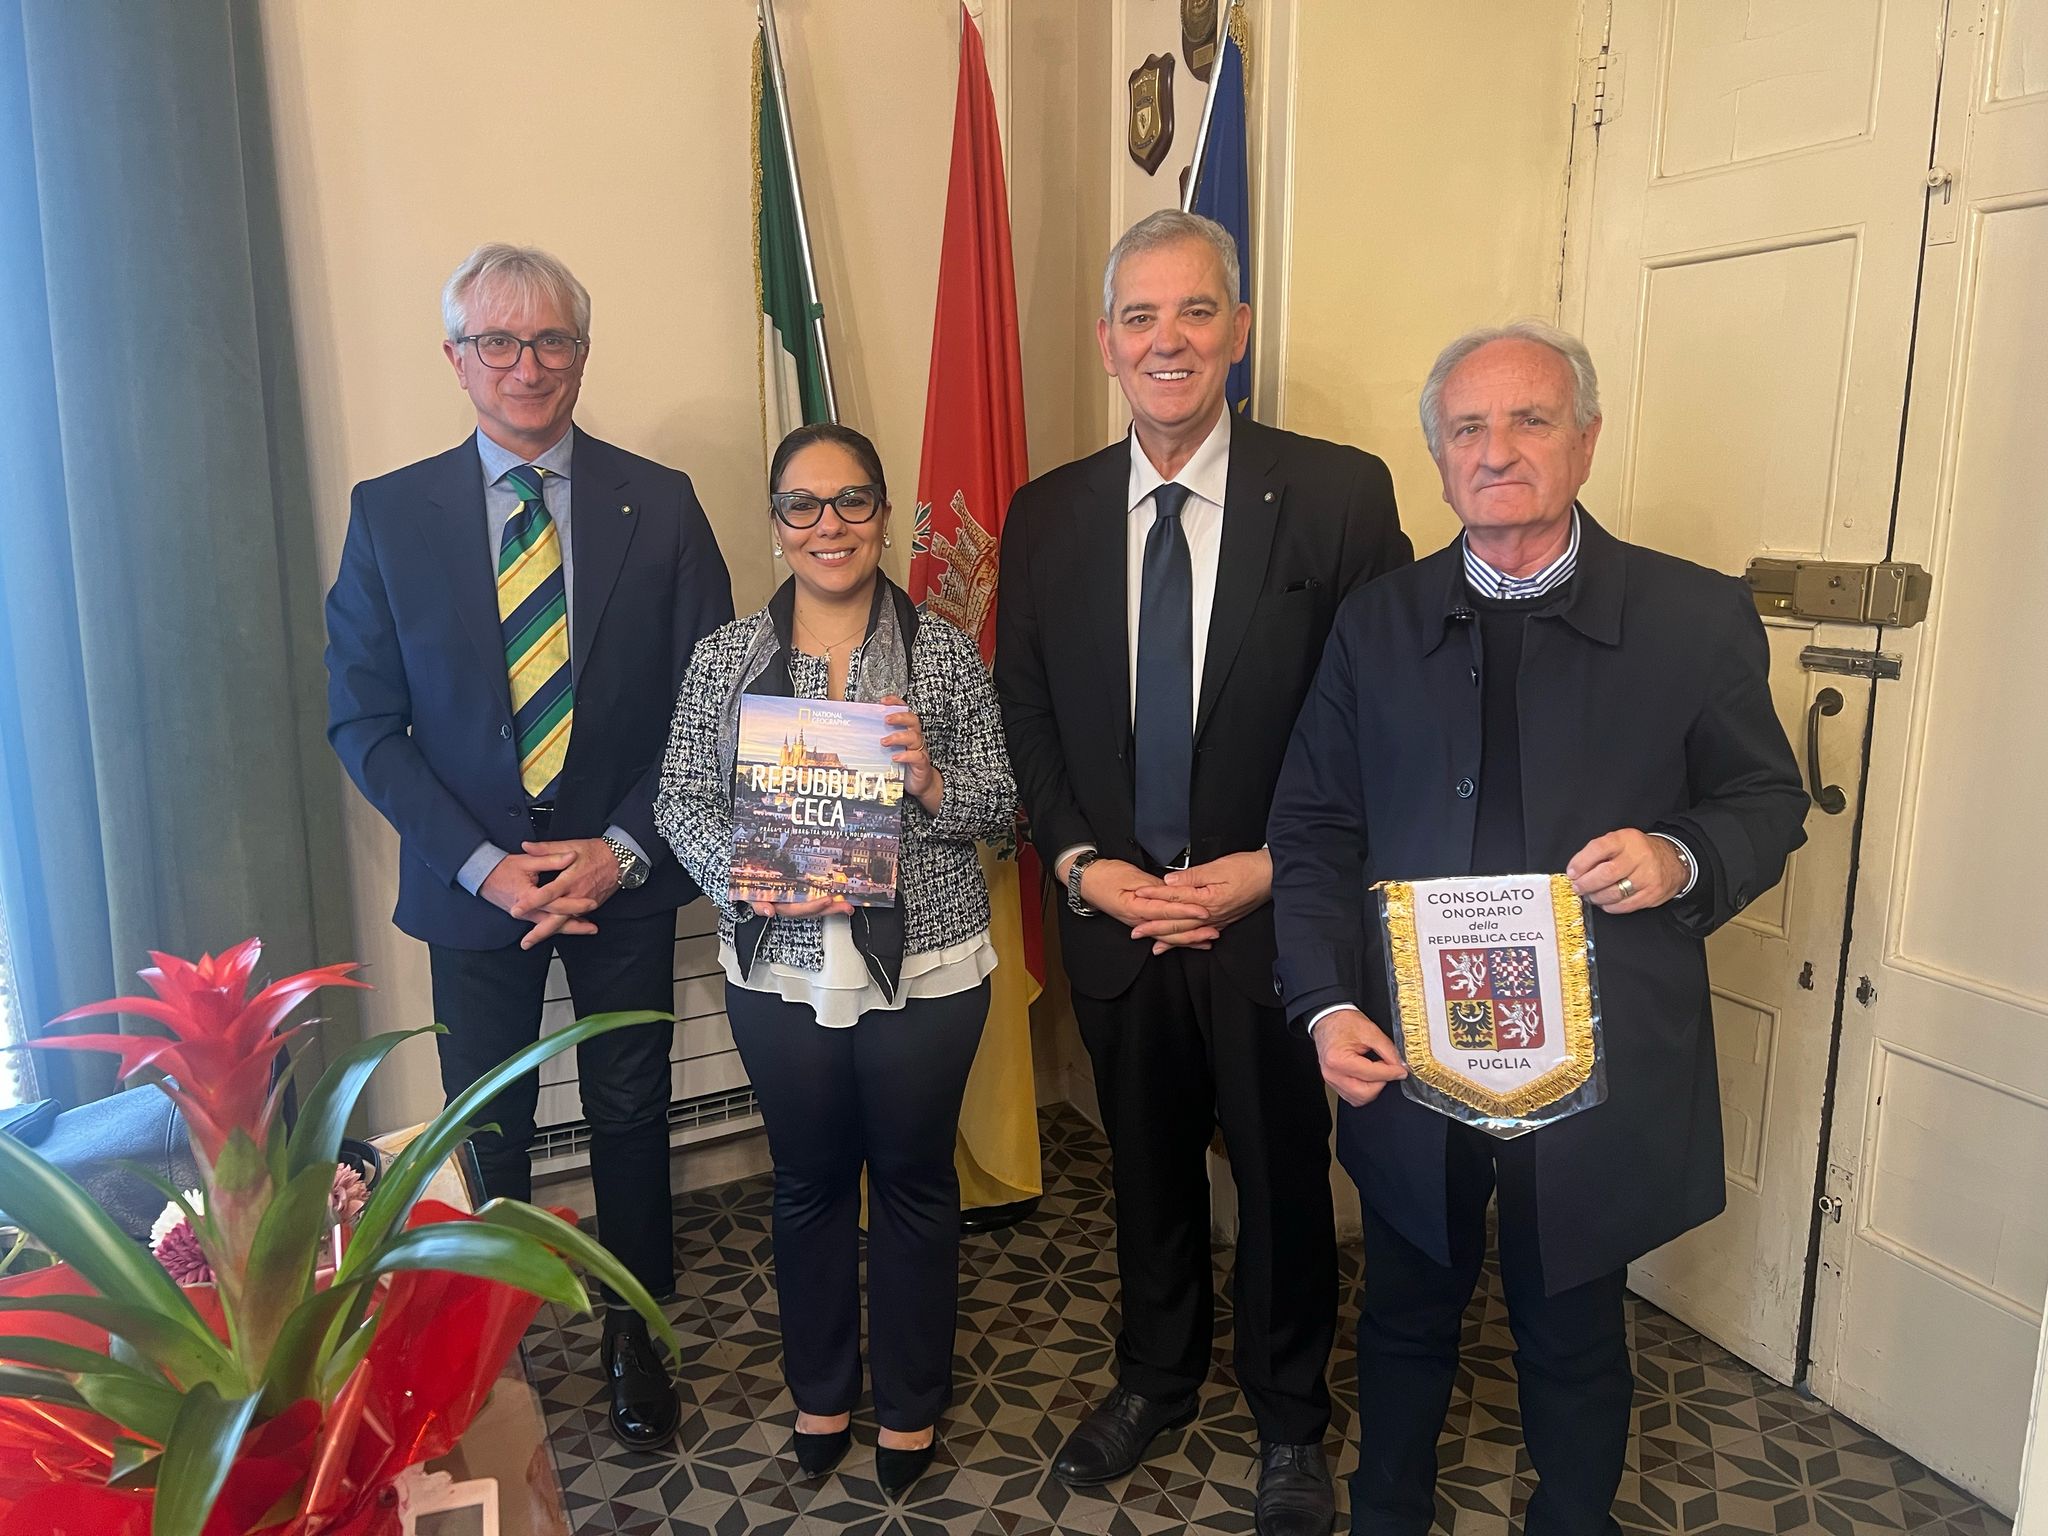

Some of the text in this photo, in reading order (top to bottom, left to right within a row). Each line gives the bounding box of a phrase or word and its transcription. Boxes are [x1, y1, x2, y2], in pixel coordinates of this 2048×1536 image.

[811, 717, 851, 726] GEOGRAPHIC
[812, 710, 843, 719] NATIONAL
[751, 764, 888, 800] REPUBBLICA
[790, 797, 846, 828] CECA
[1427, 888, 1535, 905] CONSOLATO
[1442, 905, 1523, 919] ONORARIO
[1468, 921, 1499, 931] della
[1428, 931, 1544, 945] REPUBBLICA CECA
[1468, 1056, 1531, 1070] PUGLIA
